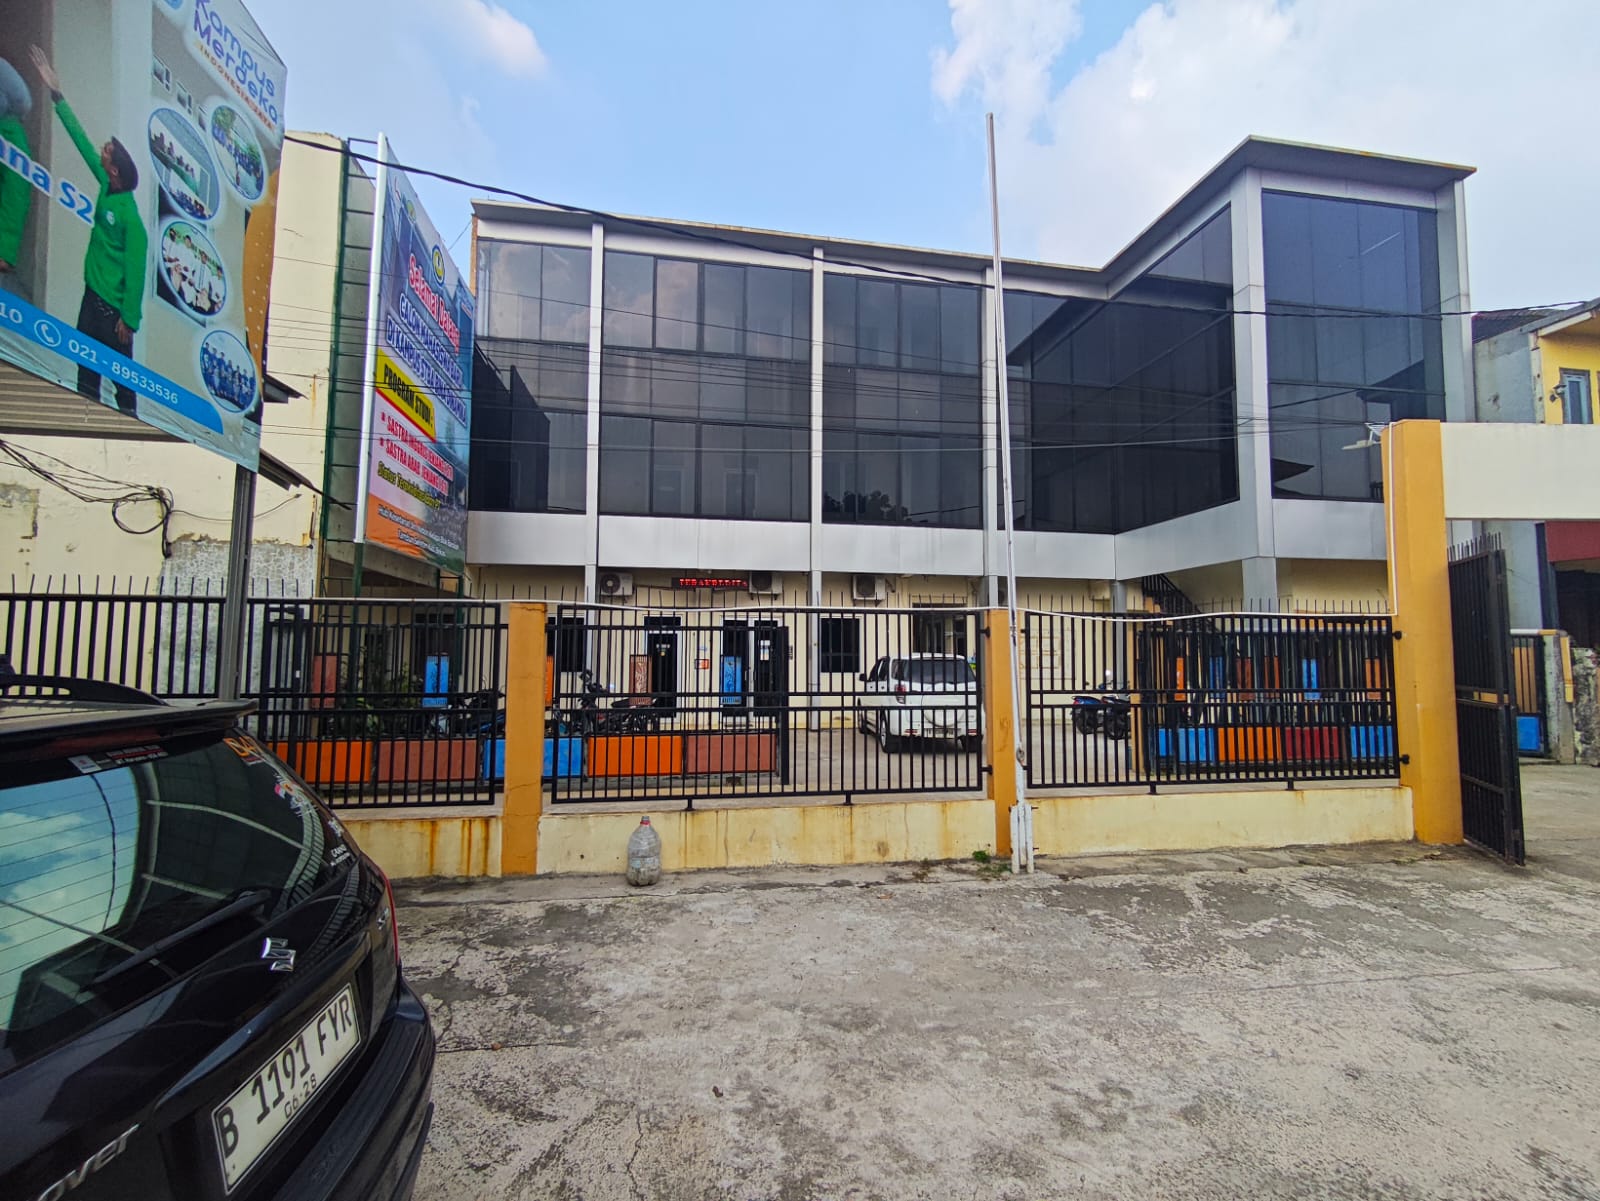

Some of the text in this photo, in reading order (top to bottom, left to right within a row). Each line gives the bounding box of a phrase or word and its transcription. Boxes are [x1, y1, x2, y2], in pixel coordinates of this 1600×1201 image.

[194, 9, 278, 125] Merdeka
[0, 138, 93, 225] na S2
[386, 315, 395, 347] DI
[409, 253, 439, 322] Selamat
[438, 297, 460, 355] Datang
[68, 338, 98, 365] 021
[111, 361, 179, 405] 89533536
[383, 362, 414, 409] PROGRAM
[386, 439, 406, 465] SASTRA
[387, 415, 408, 443] SASTRA
[218, 993, 353, 1160] B 1191 FYR
